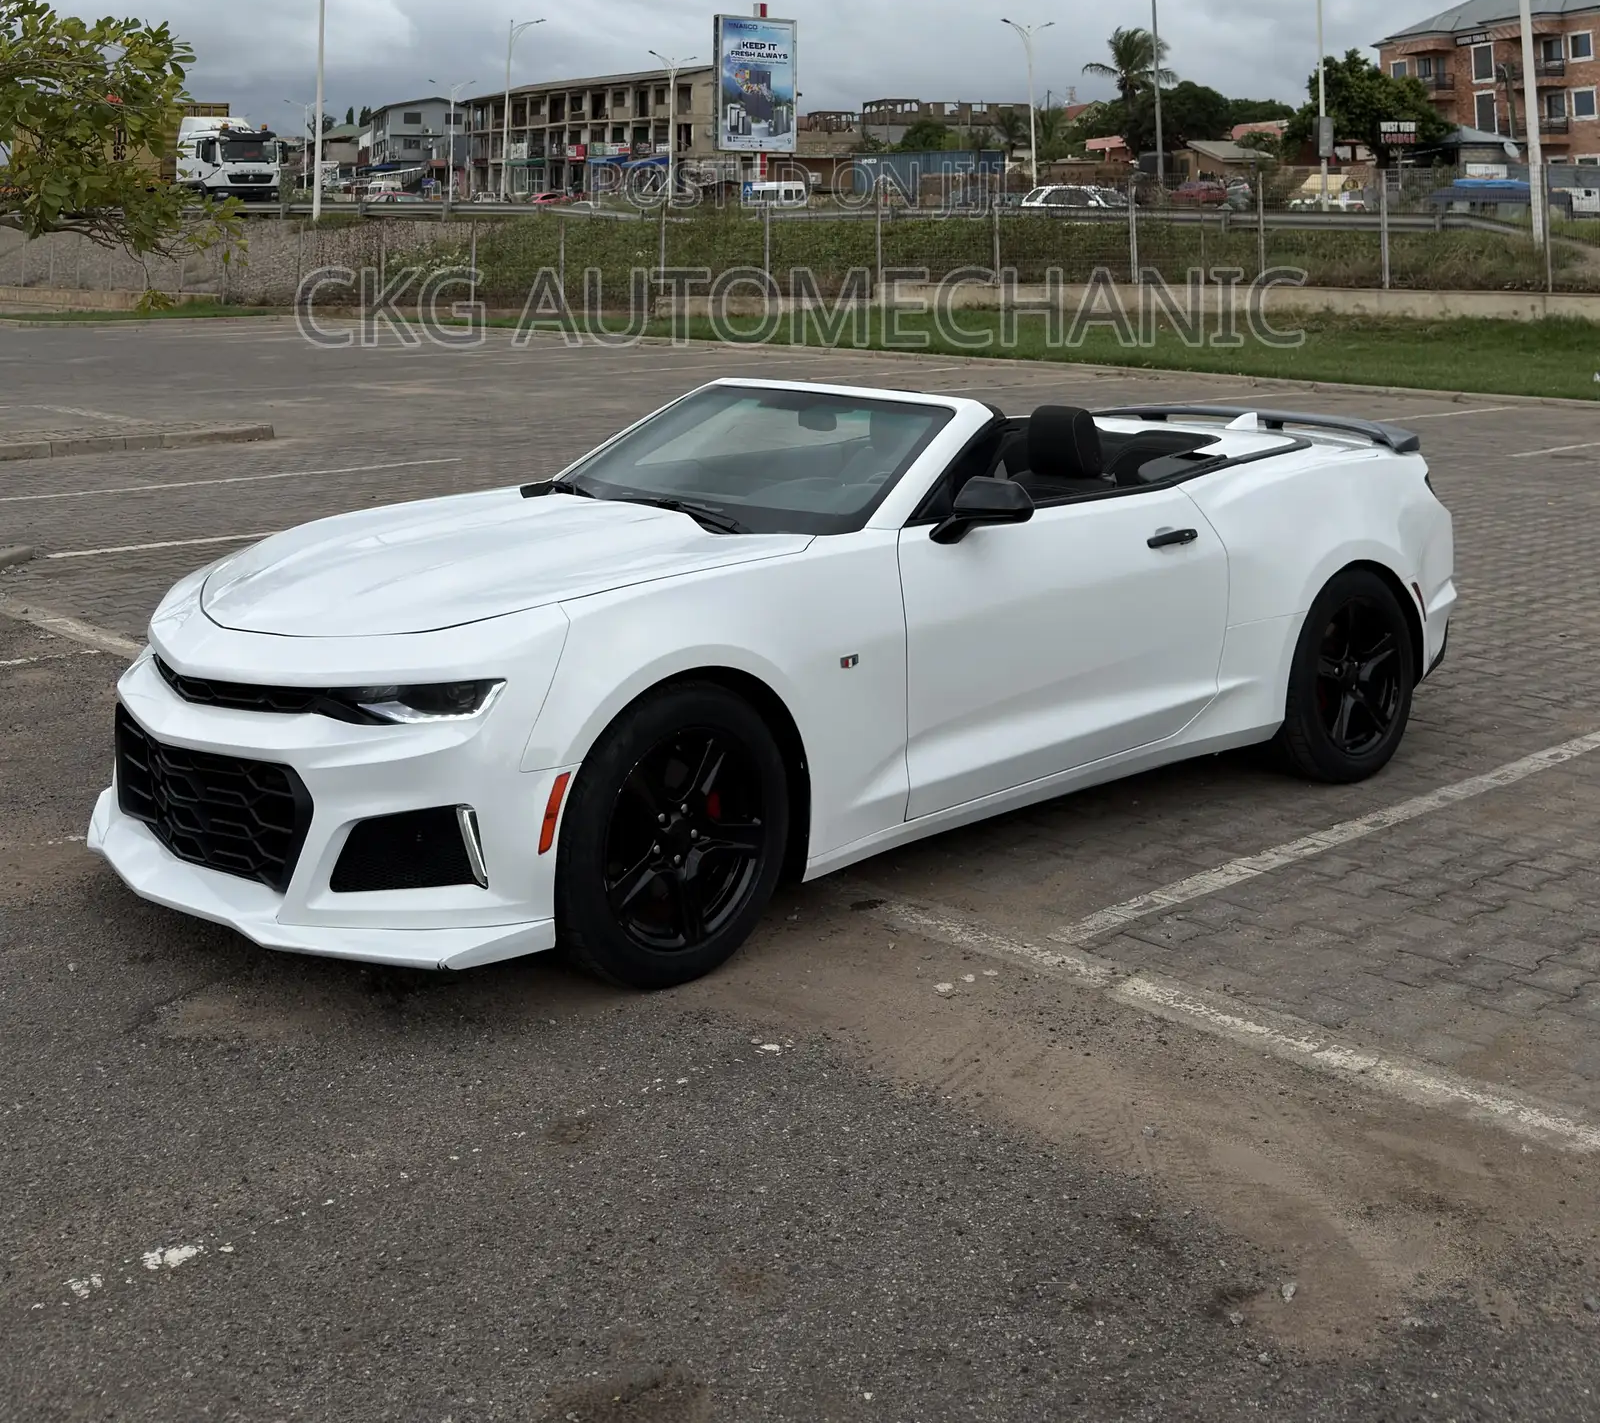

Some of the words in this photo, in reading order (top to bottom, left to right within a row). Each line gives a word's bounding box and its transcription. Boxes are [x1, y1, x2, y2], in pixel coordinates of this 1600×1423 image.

[742, 41, 766, 50] KEEP
[768, 43, 777, 51] IT
[730, 50, 756, 58] FRESH
[1380, 121, 1398, 133] WEST
[1399, 121, 1416, 133] VIEW
